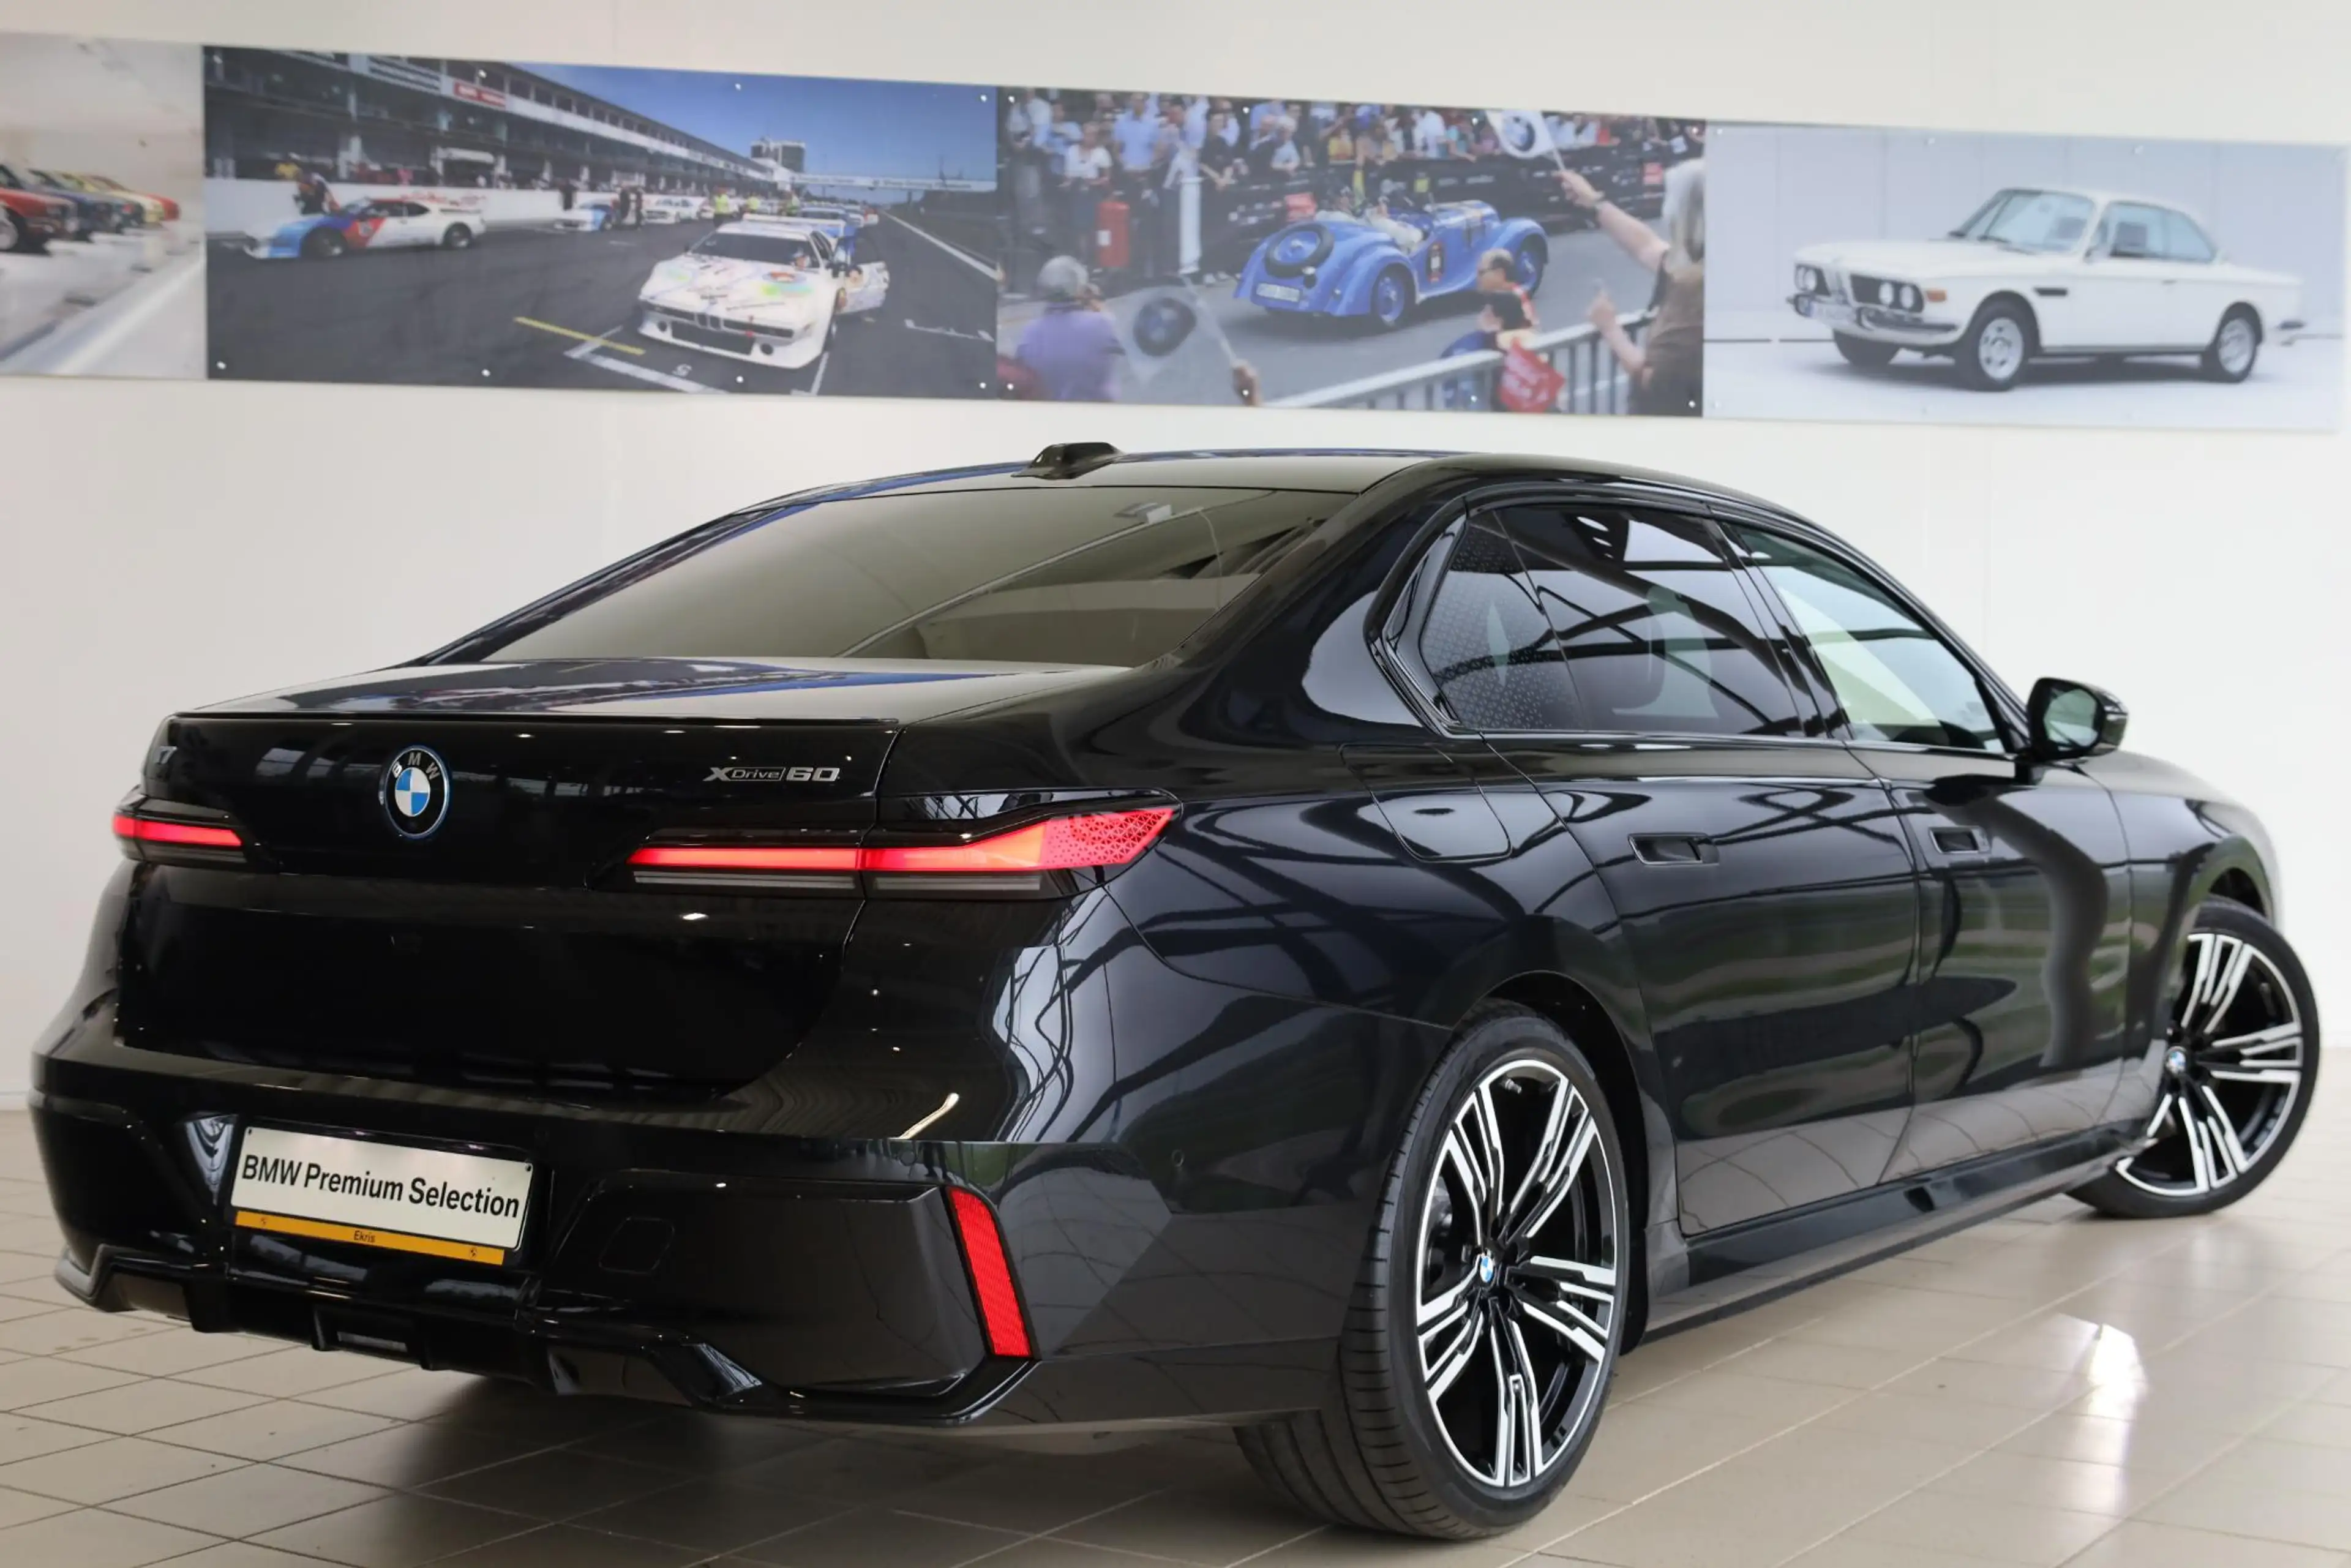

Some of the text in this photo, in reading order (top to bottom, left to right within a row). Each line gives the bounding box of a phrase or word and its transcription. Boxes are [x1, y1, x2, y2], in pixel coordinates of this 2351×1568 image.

[392, 752, 440, 780] BMW
[786, 767, 840, 782] 60
[242, 1155, 520, 1218] BMW Premium Selection
[353, 1229, 376, 1243] Ekris
